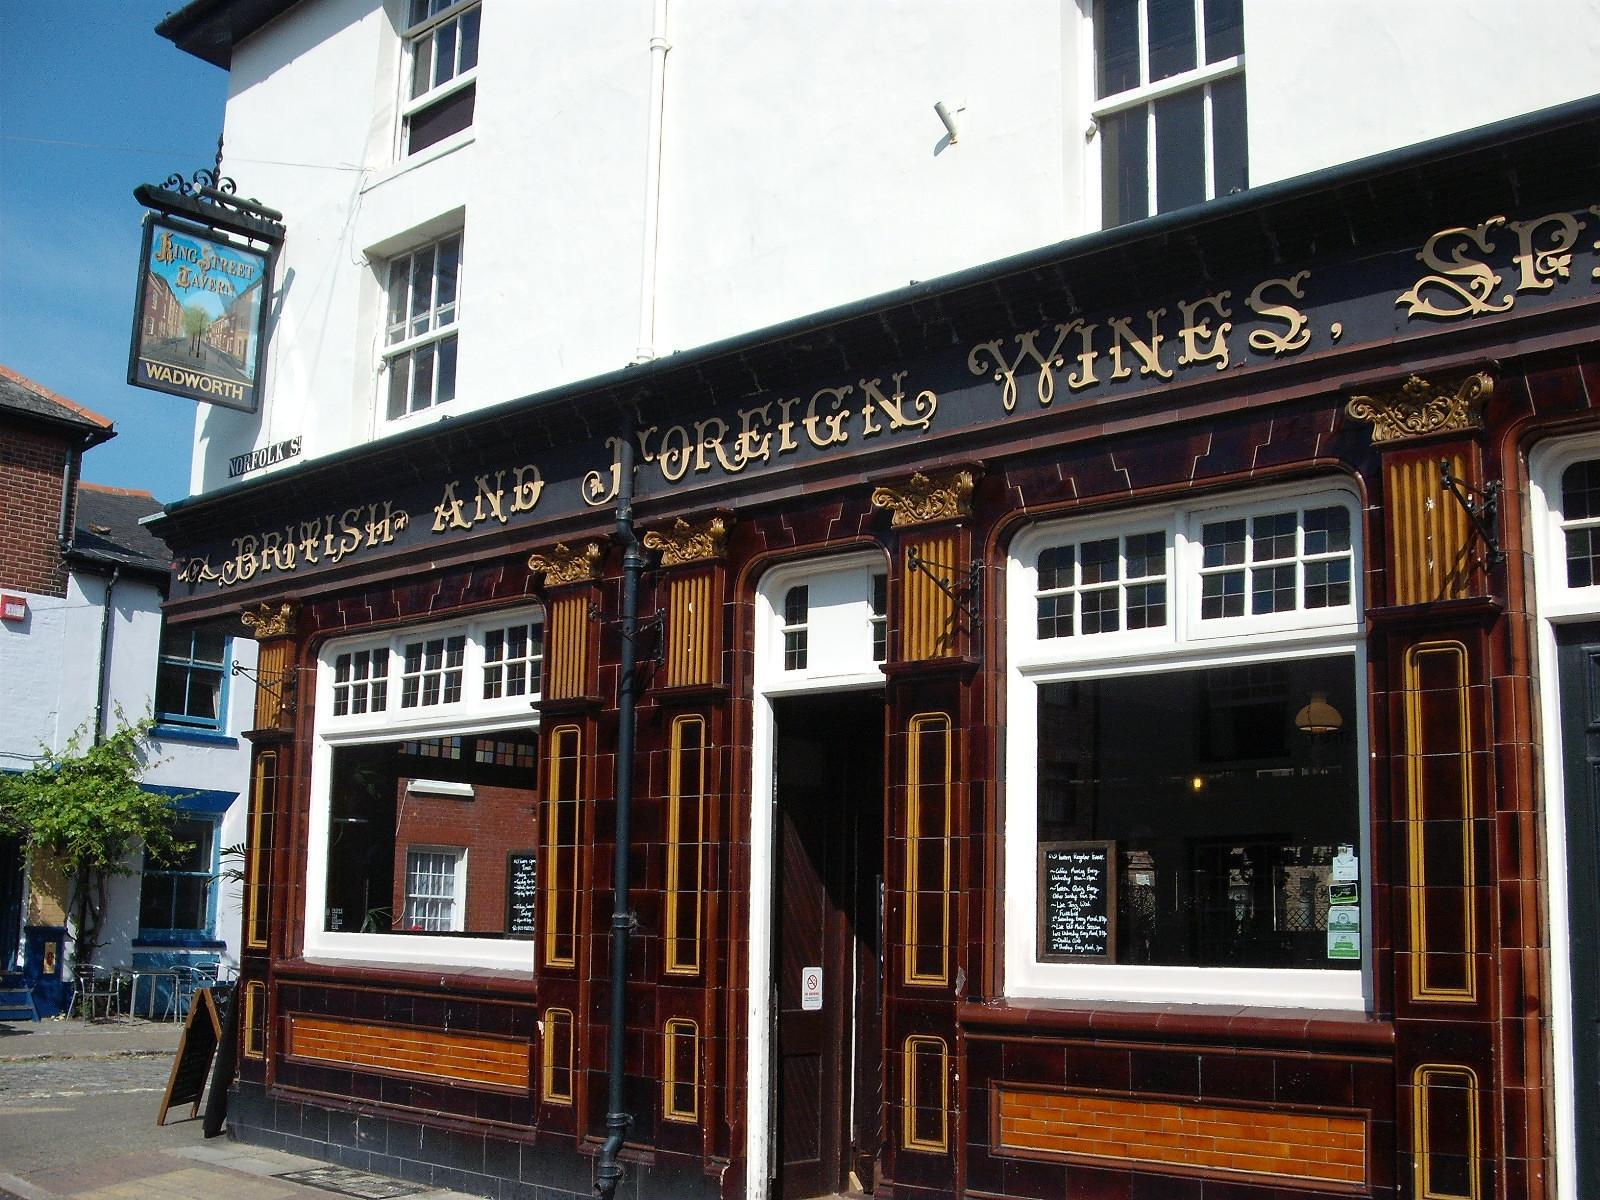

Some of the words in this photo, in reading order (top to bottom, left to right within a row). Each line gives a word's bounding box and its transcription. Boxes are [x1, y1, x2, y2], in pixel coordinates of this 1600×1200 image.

[198, 243, 254, 280] STREET
[176, 265, 235, 297] TAVERN
[145, 363, 243, 400] WADWORTH
[219, 501, 409, 586] BRITISH
[432, 464, 544, 533] AND
[1396, 205, 1600, 317] SP
[228, 442, 284, 477] NORFOLK
